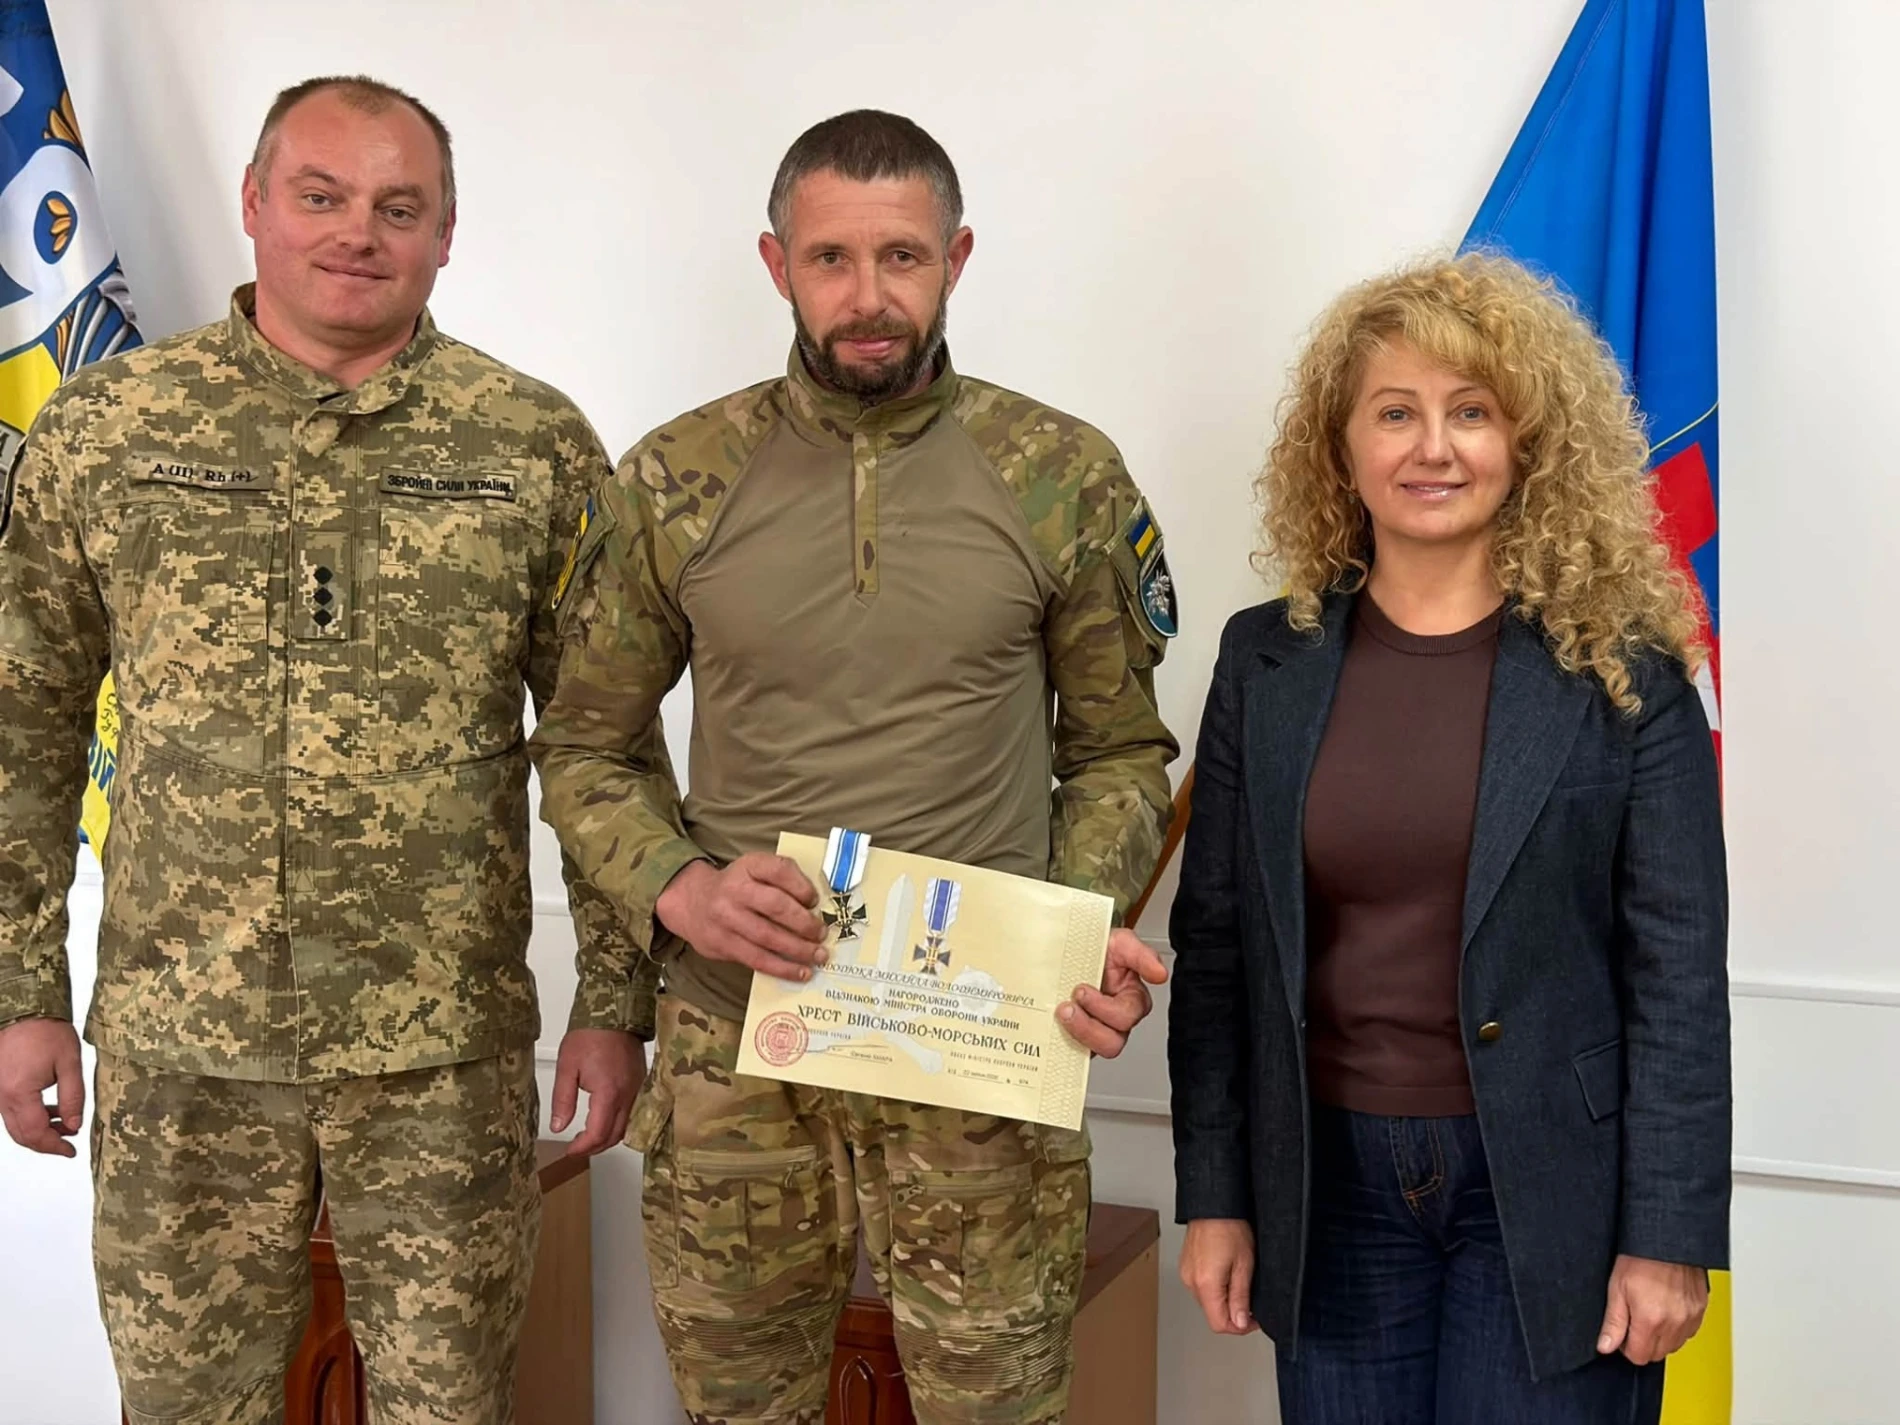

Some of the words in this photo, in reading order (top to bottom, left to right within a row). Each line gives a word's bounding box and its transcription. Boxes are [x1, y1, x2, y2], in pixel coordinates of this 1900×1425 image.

[152, 463, 165, 474] A
[387, 474, 433, 491] ЗБРОЙНІ
[436, 479, 465, 492] СИЛИ
[467, 478, 511, 493] УКРАЇНИ
[888, 988, 960, 1009] НАГОРОДЖЕНО
[825, 989, 880, 1006] ВІДЗНАКОЮ
[884, 998, 927, 1015] МІНІСТРА
[930, 1006, 979, 1024] ОБОРОНИ
[981, 1014, 1021, 1031] УКРАЇНИ
[795, 1004, 842, 1024] ХРЕСТ
[847, 1011, 1009, 1052] ВІЙСЬКОВО-МОРСЬКИХ
[1013, 1041, 1042, 1059] СИЛ
